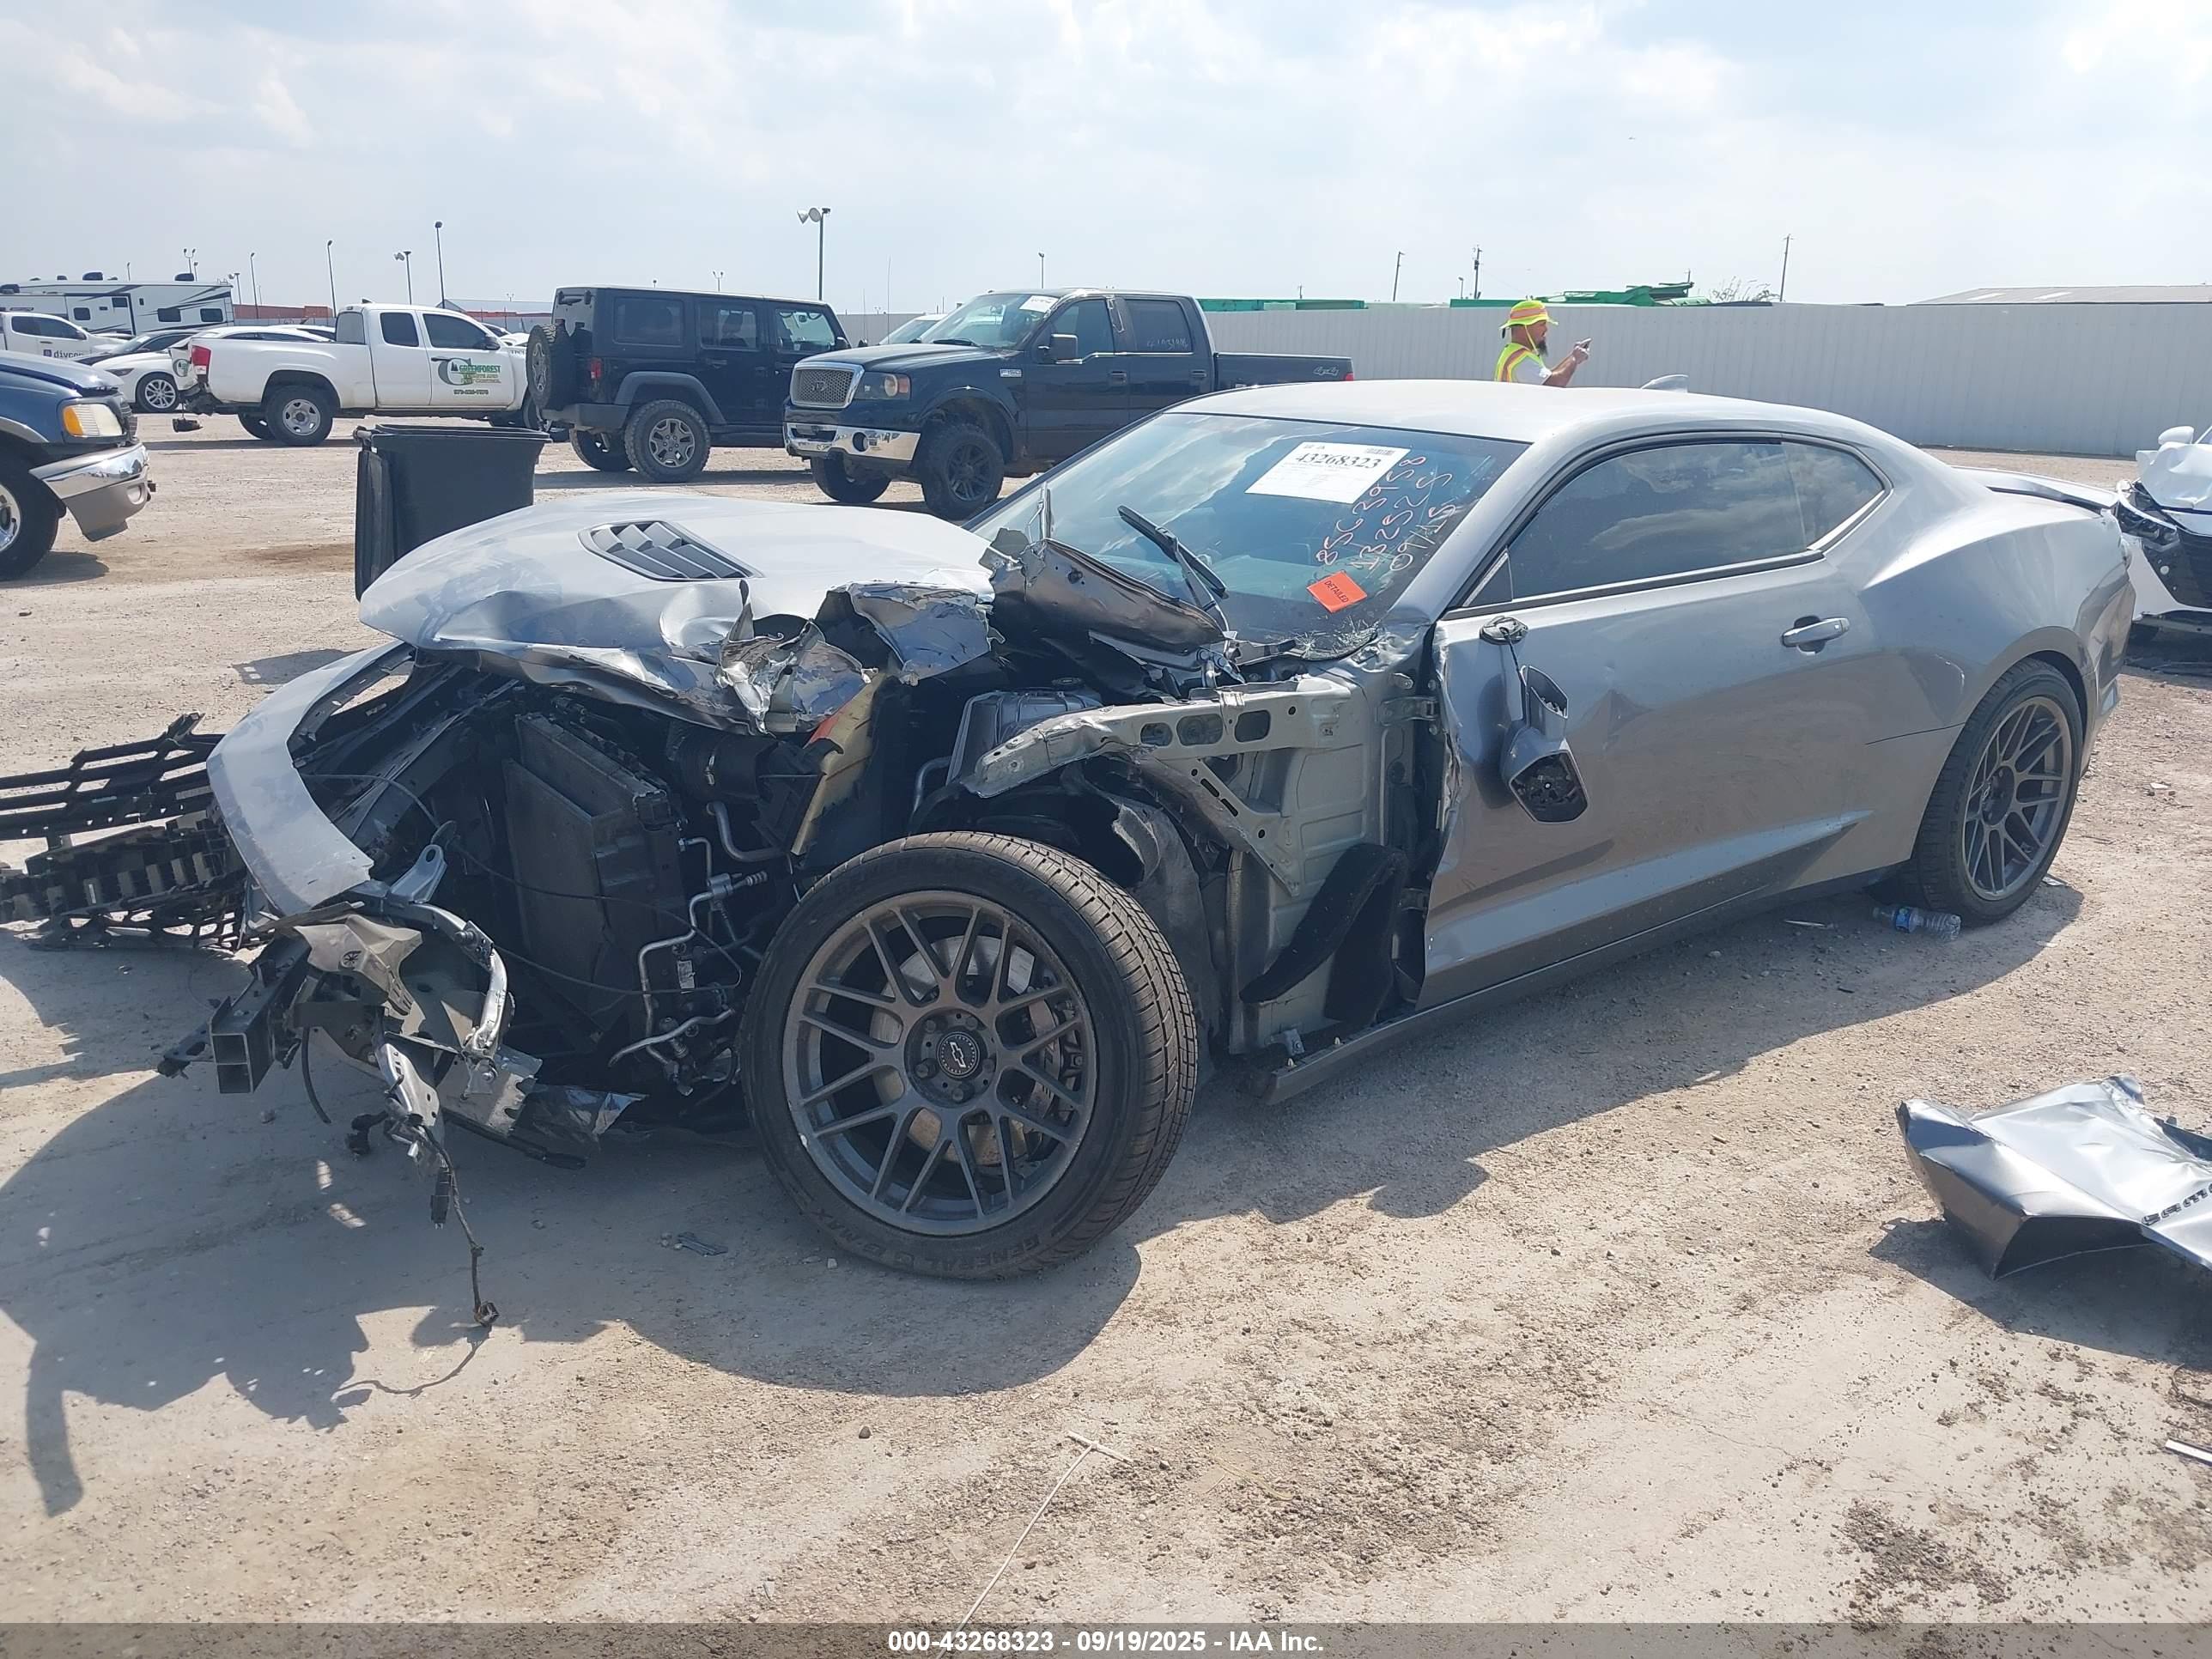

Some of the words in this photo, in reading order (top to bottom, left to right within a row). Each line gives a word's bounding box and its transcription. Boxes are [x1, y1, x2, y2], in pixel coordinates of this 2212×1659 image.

[459, 364, 501, 373] GREENFOREST
[1295, 453, 1382, 469] 43268323
[1324, 580, 1349, 603] DETAILED
